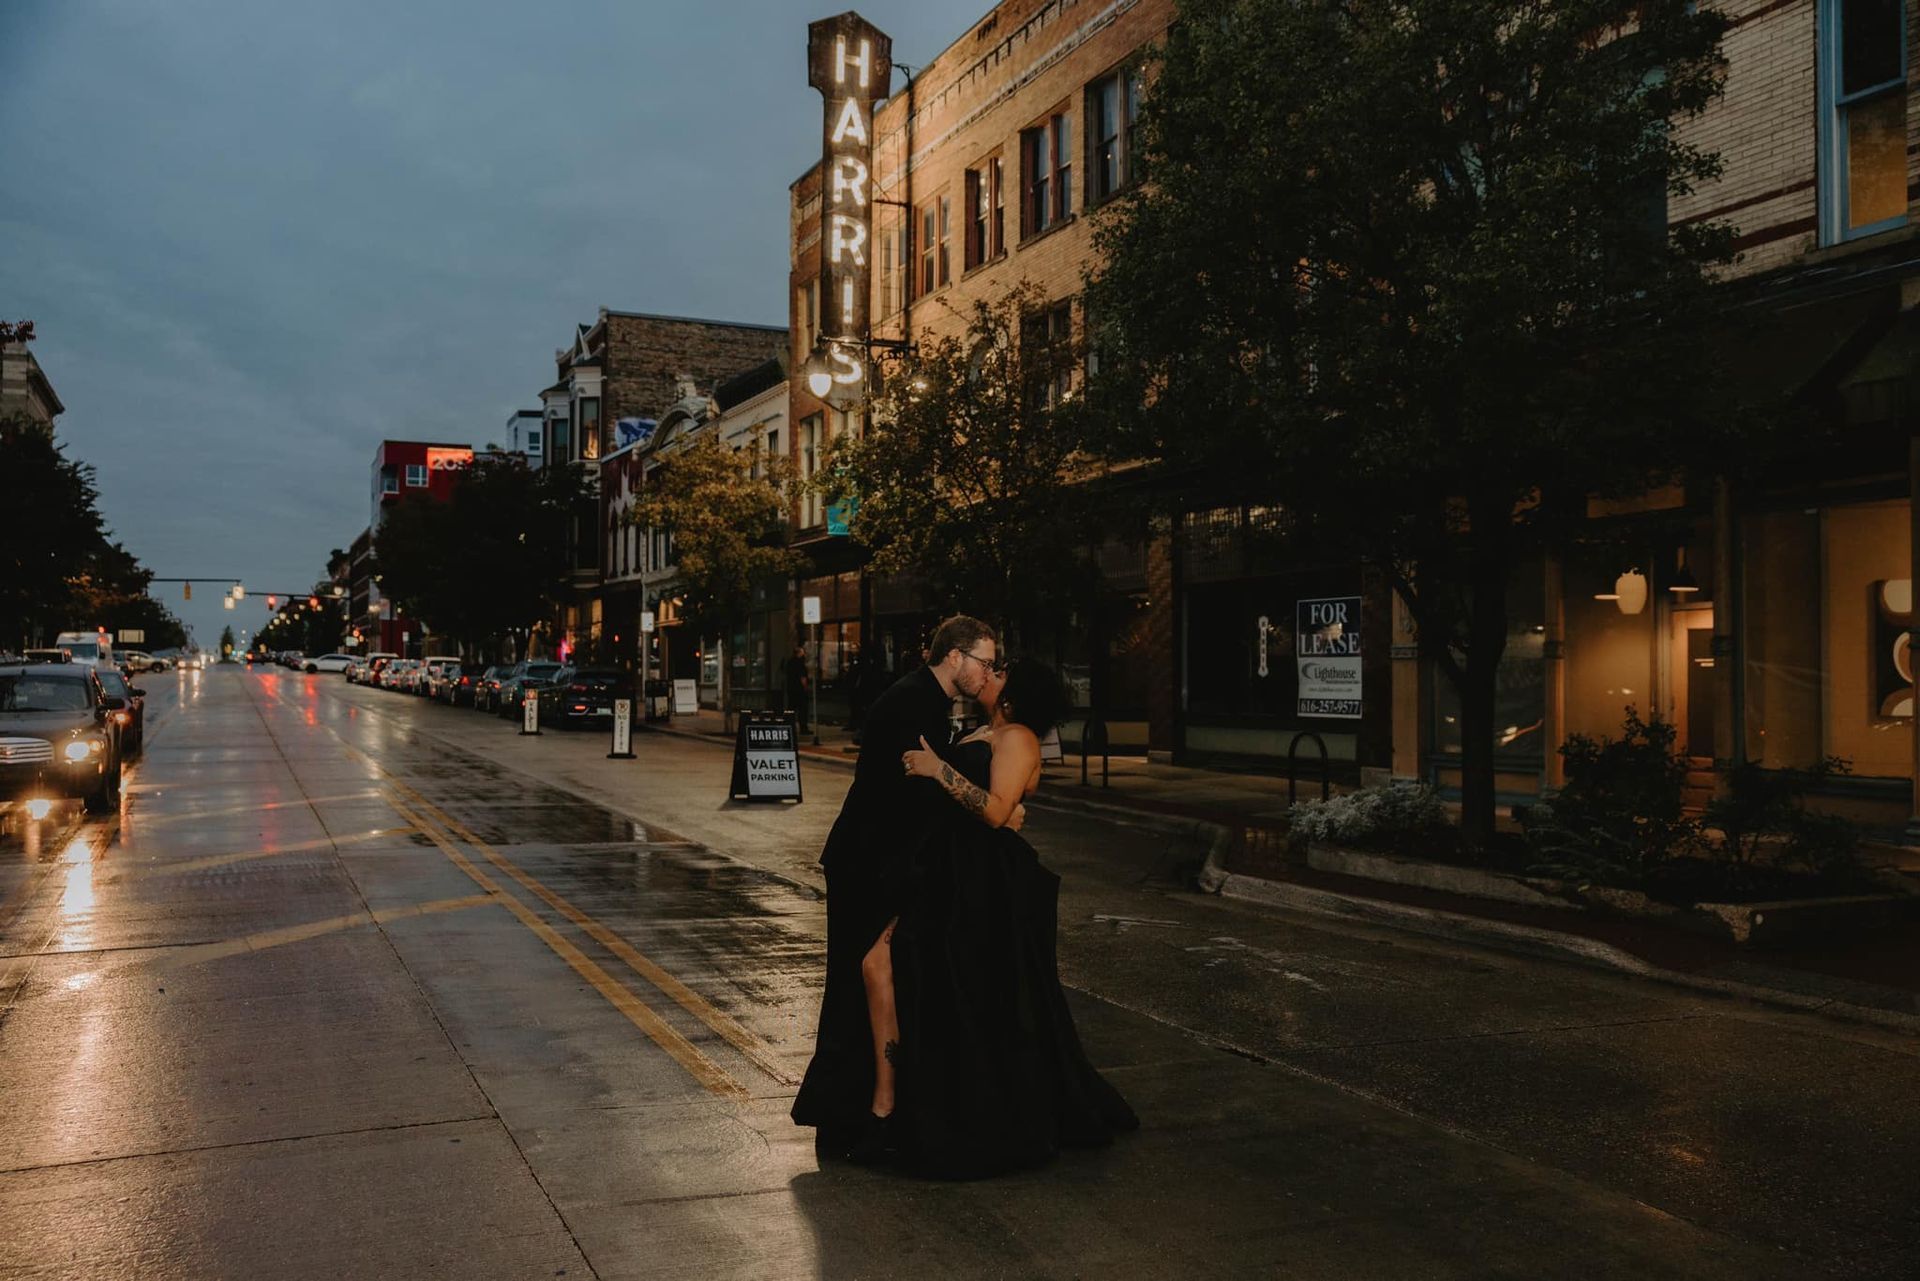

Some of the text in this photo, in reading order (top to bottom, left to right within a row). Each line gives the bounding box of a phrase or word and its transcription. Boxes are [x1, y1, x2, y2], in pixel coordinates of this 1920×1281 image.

[831, 33, 870, 384] HARRIS
[1311, 602, 1348, 625] FOR
[1300, 632, 1361, 655] LEASE
[1314, 667, 1357, 682] Lighthouse
[1300, 700, 1361, 714] 616-257-9577
[750, 729, 790, 741] HARRIS
[749, 759, 795, 770] VALET
[750, 773, 796, 782] PARKING
